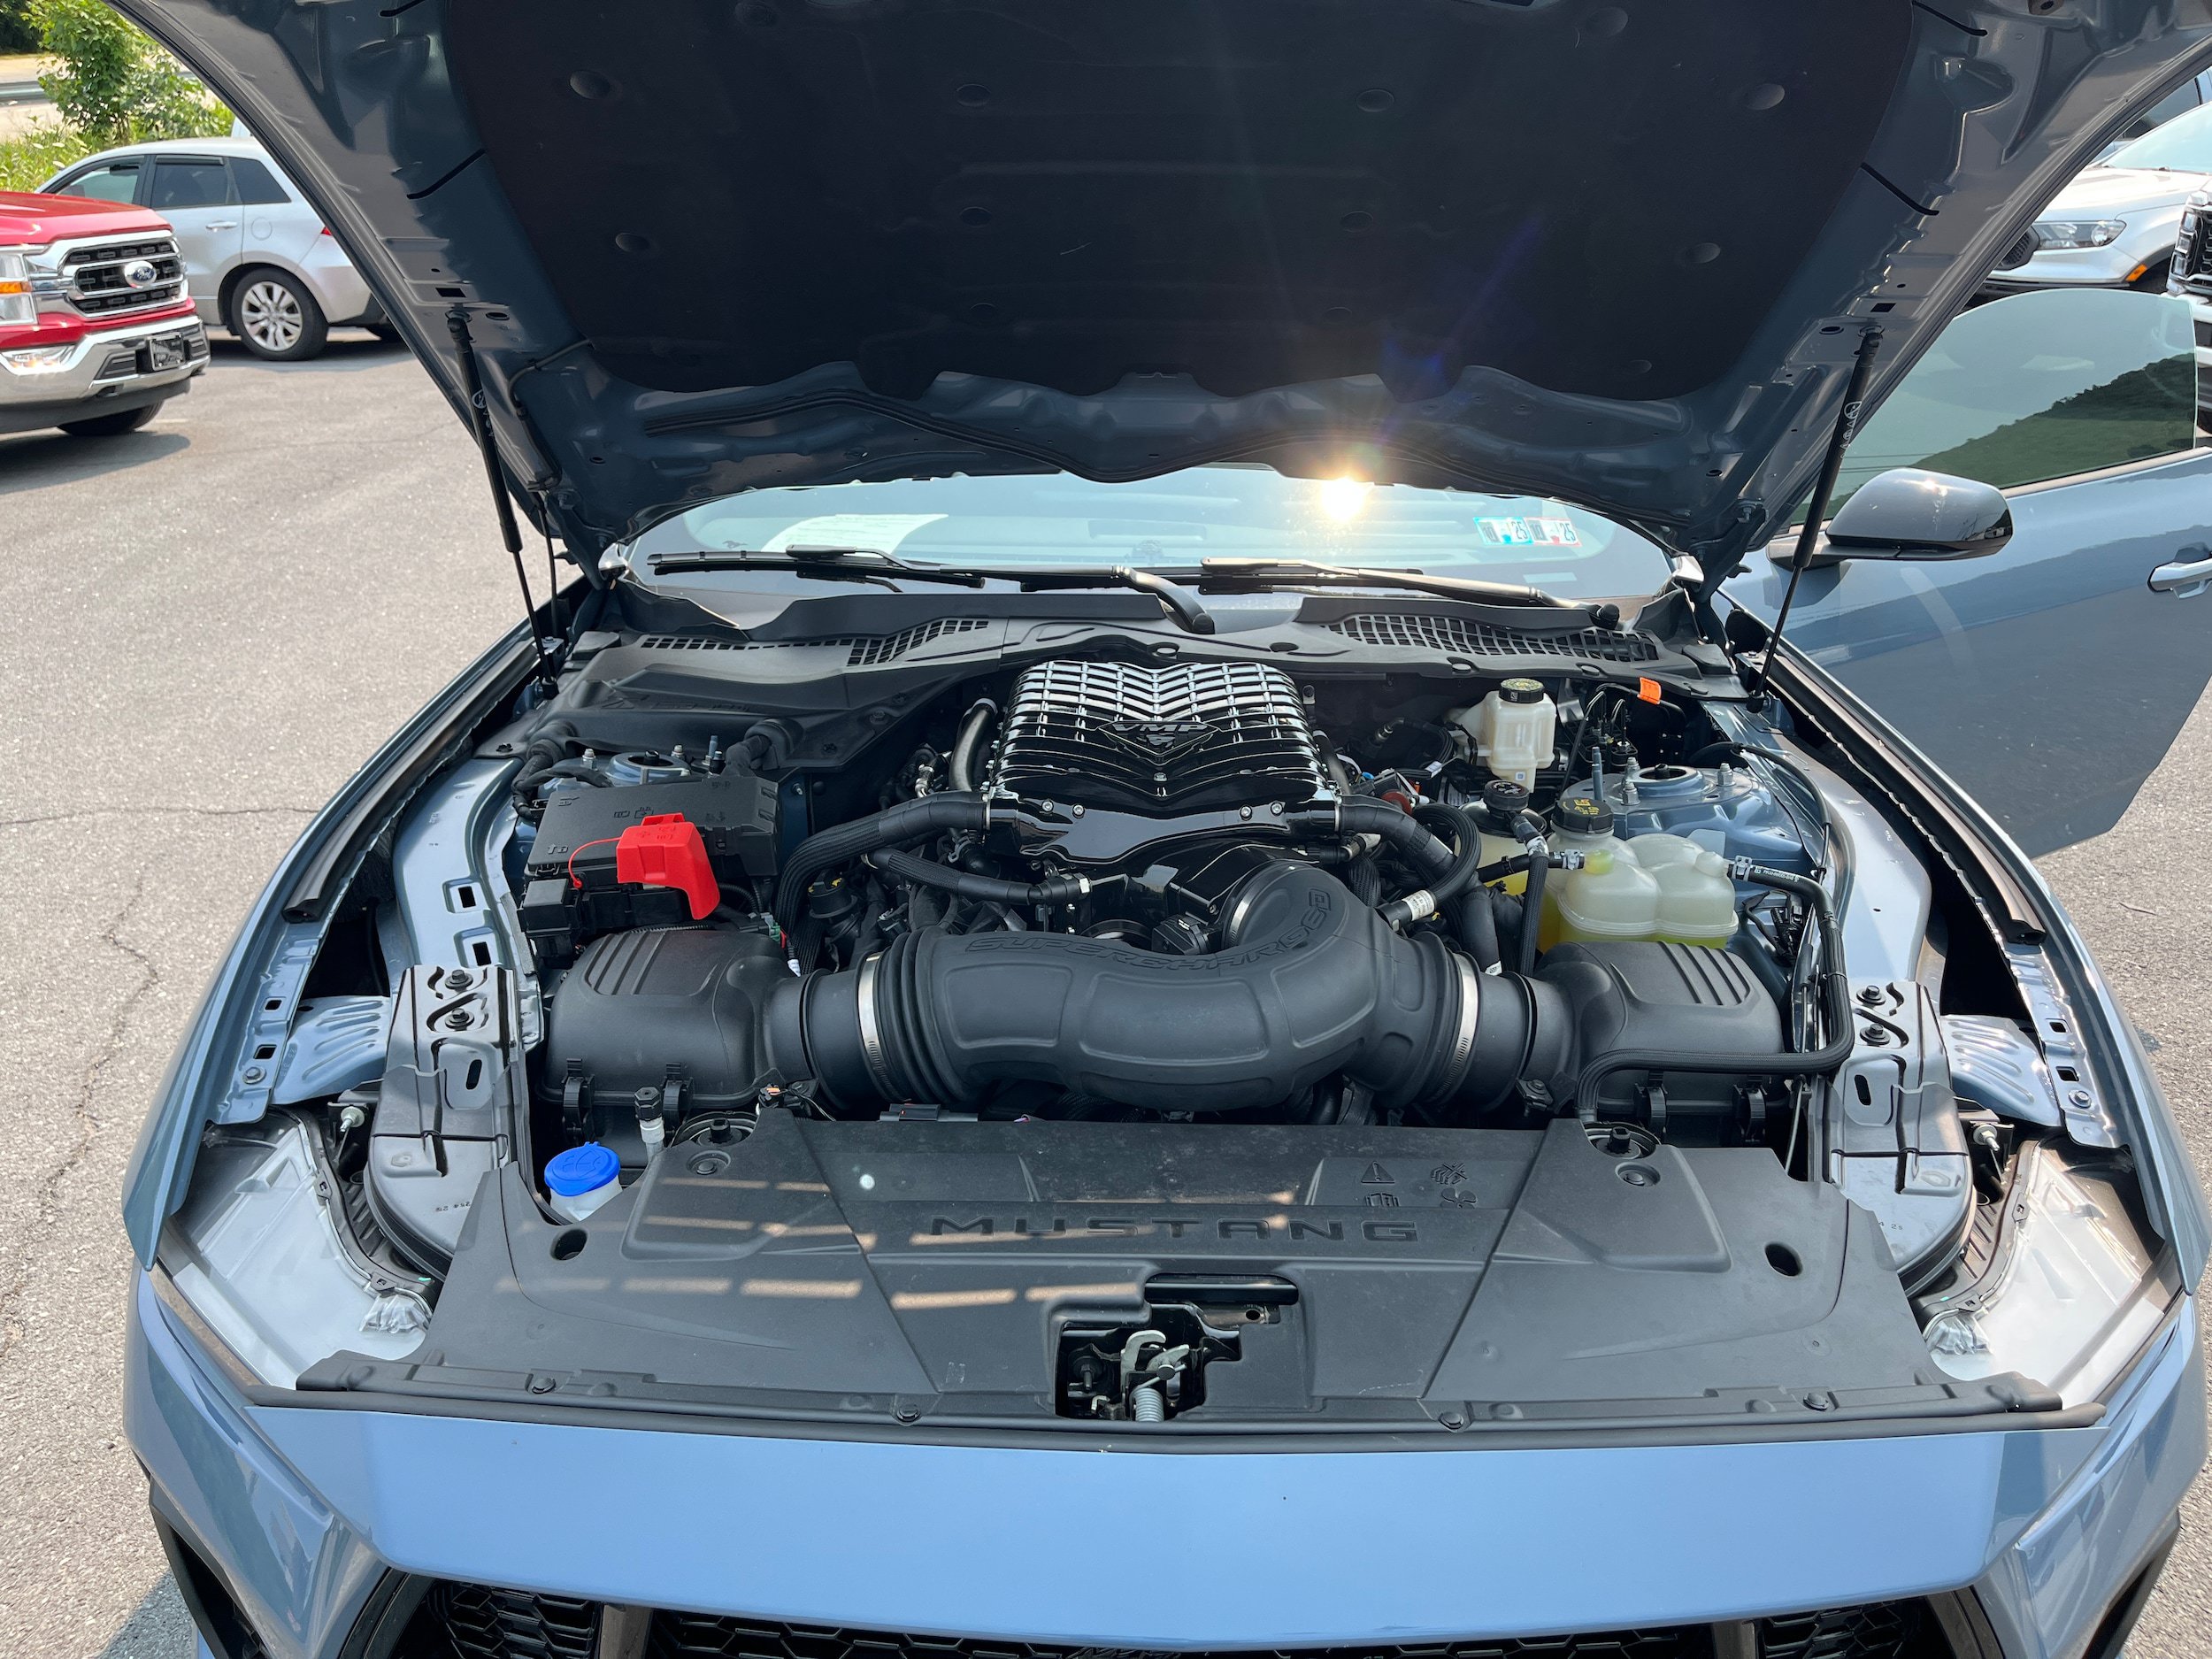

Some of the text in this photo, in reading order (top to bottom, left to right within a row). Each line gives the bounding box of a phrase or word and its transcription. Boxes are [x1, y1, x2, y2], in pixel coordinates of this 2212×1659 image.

[1510, 521, 1528, 540] 25
[1560, 523, 1576, 541] 25
[1111, 723, 1209, 733] VMP
[964, 887, 1333, 971] SUPERCHARGED
[930, 1215, 1419, 1242] MUSTANG
